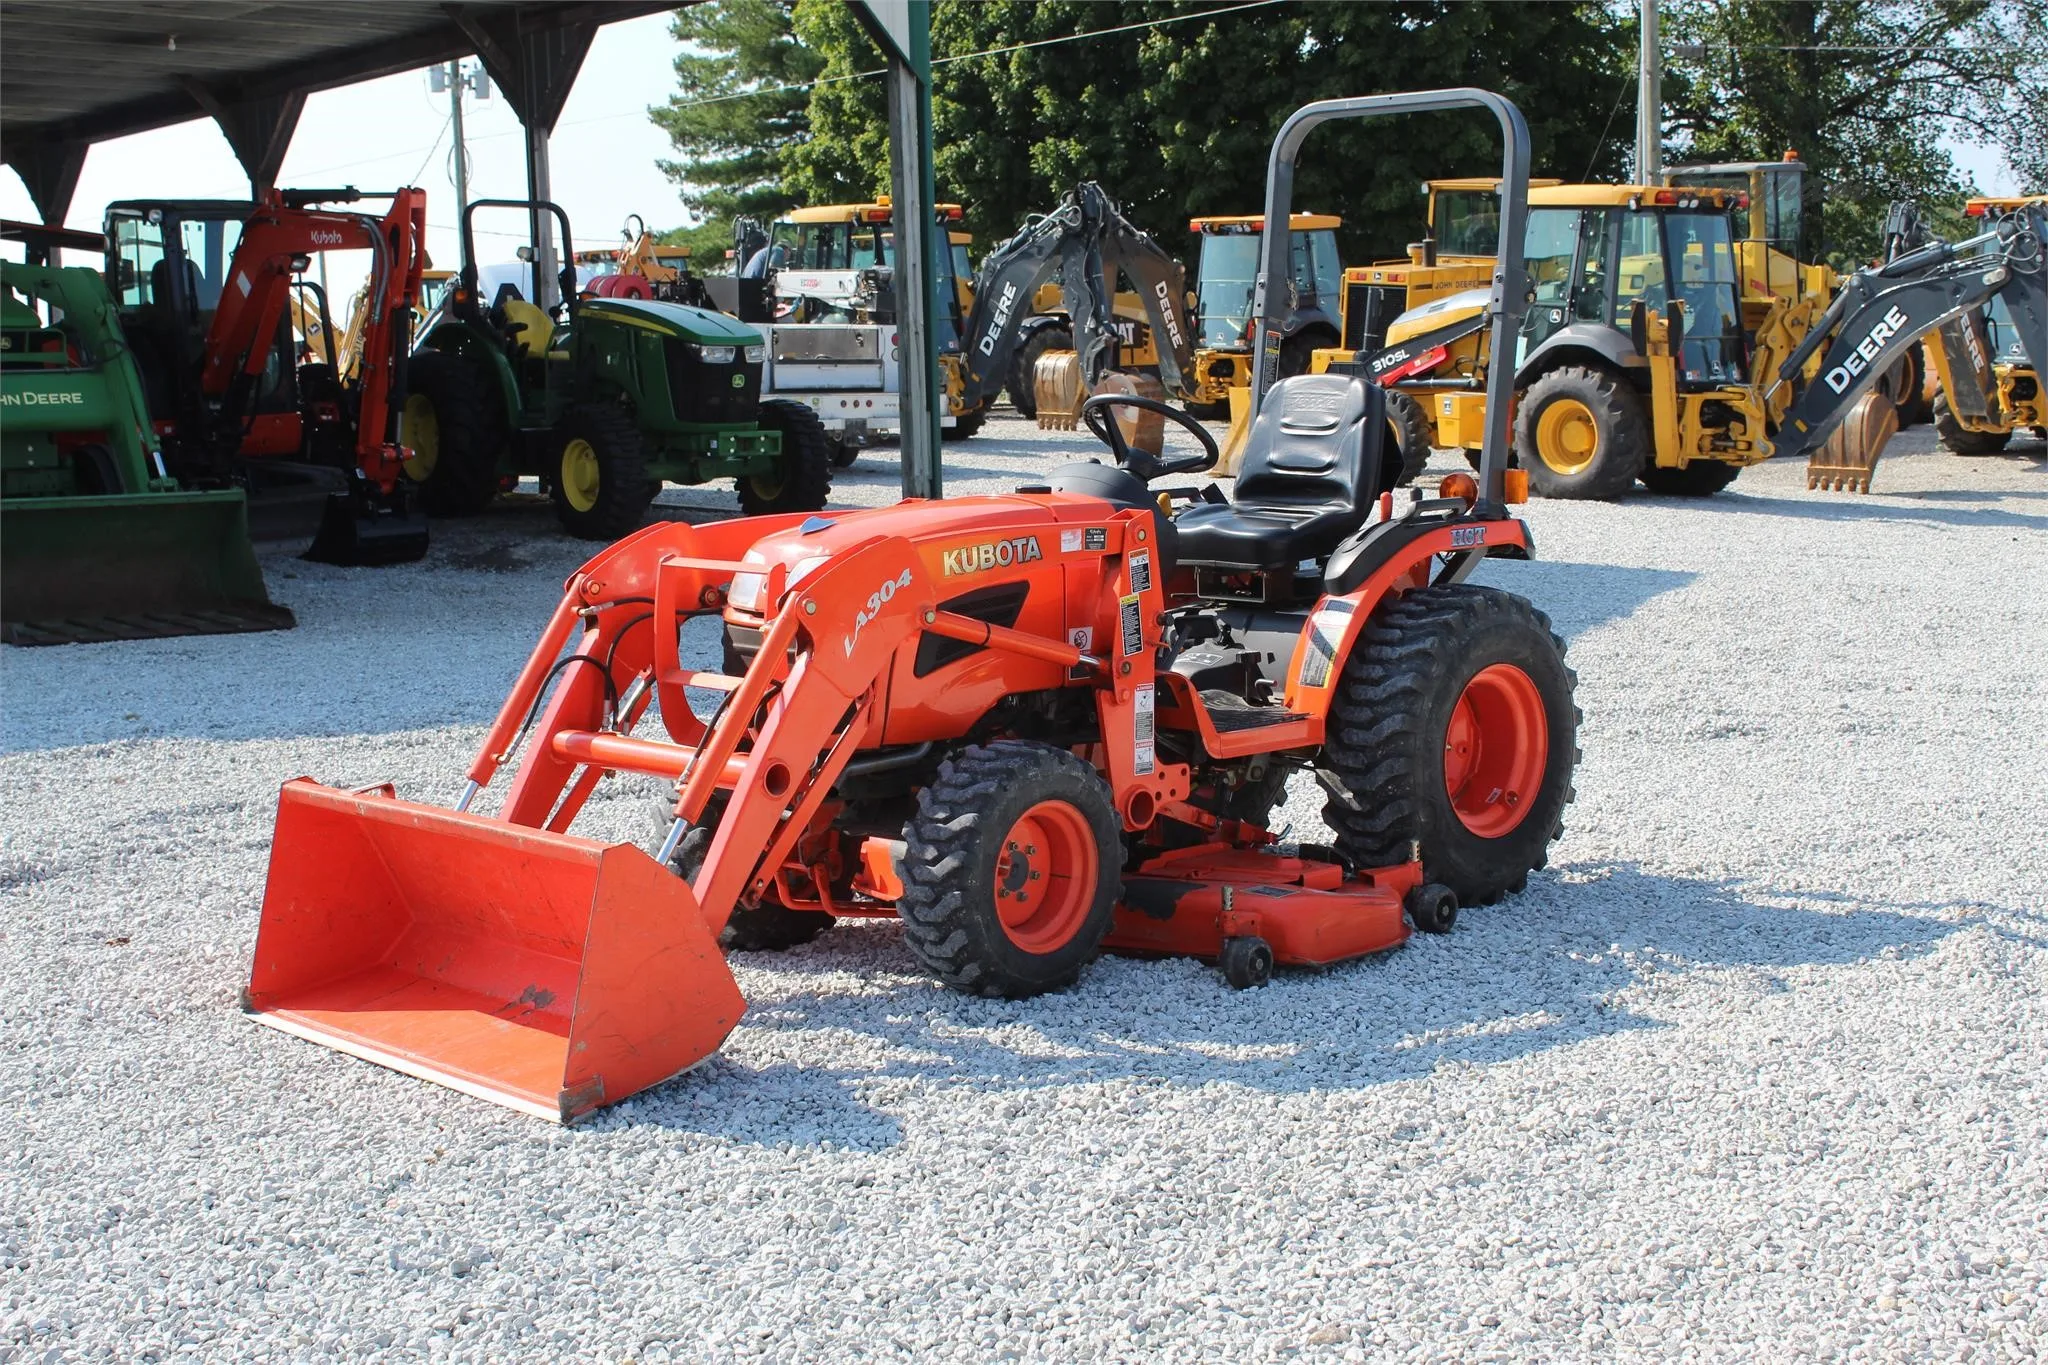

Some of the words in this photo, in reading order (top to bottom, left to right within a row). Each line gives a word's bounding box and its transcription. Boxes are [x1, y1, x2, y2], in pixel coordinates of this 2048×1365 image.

[311, 230, 343, 244] Kubota
[1435, 281, 1452, 289] JOHN
[1456, 280, 1479, 289] DEERE
[979, 281, 1017, 357] DEERE
[1155, 280, 1183, 349] DEERE
[1372, 349, 1410, 373] 310SL
[1825, 305, 1908, 395] DEERE
[1961, 311, 1985, 374] EERE
[0, 394, 21, 405] HN
[22, 391, 84, 405] DEERE
[943, 535, 1043, 577] KUBOTA
[1451, 526, 1487, 547] HST
[844, 567, 913, 659] LA304
